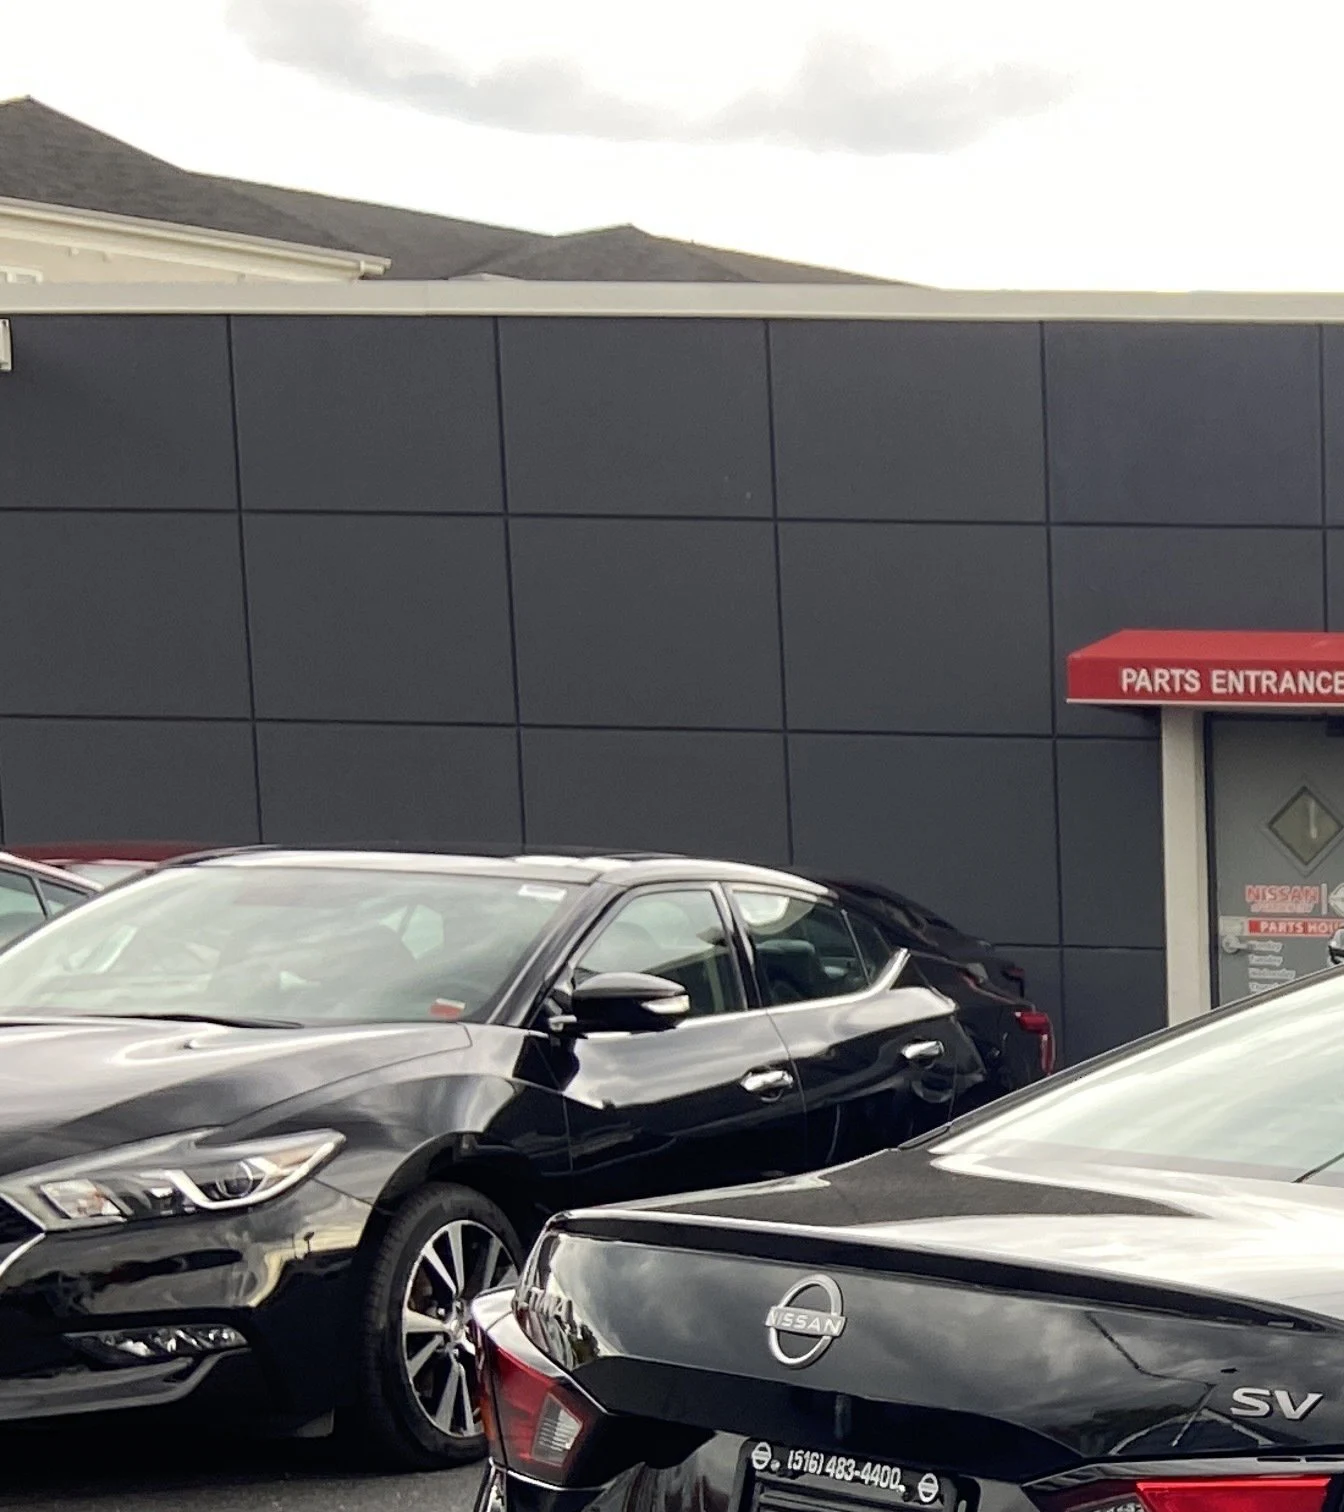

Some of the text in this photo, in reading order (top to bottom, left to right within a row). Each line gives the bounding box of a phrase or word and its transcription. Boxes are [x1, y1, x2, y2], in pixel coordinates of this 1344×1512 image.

[1121, 668, 1201, 693] PARTS
[1260, 921, 1304, 934] PARTS
[769, 1308, 842, 1335] NISSAN
[1230, 1387, 1323, 1420] SV
[788, 1449, 903, 1490] (516) 483-4400
